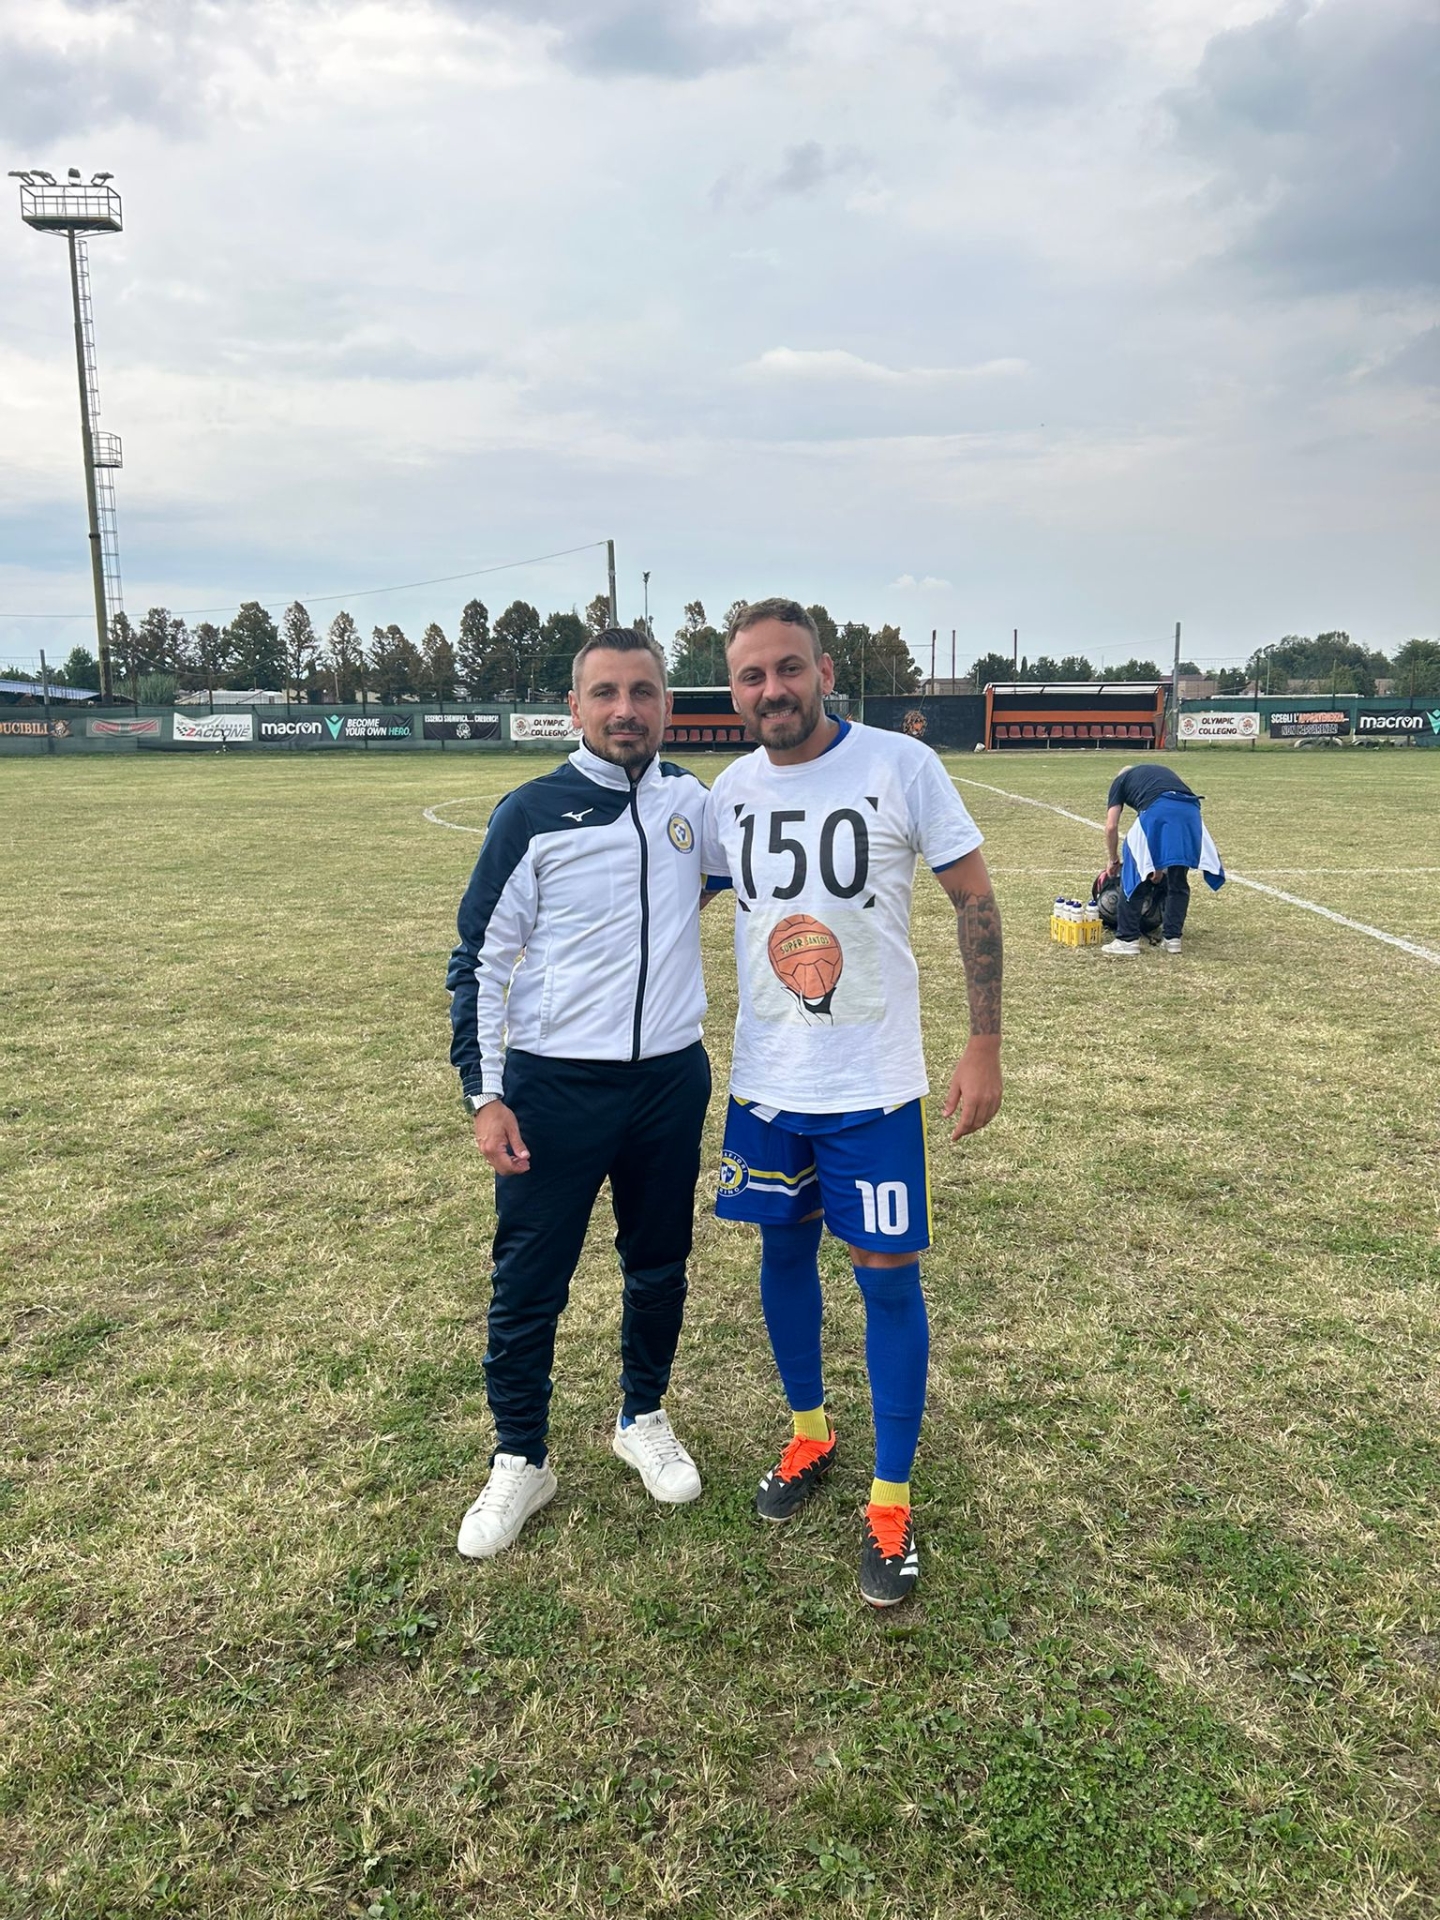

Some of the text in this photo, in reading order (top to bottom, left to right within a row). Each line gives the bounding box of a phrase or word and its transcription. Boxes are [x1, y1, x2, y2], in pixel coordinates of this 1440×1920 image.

[347, 718, 380, 728] BECOME
[533, 719, 565, 727] OLYMPIC
[1201, 717, 1235, 725] OLYMPIC
[1360, 716, 1423, 728] macron
[261, 722, 322, 735] macron
[345, 727, 366, 736] YOUR
[366, 727, 387, 736] OWN
[530, 729, 568, 737] COLLEGNO
[739, 808, 869, 900] 150
[780, 936, 829, 954] SUPER SANTOS
[855, 1180, 909, 1235] 10
